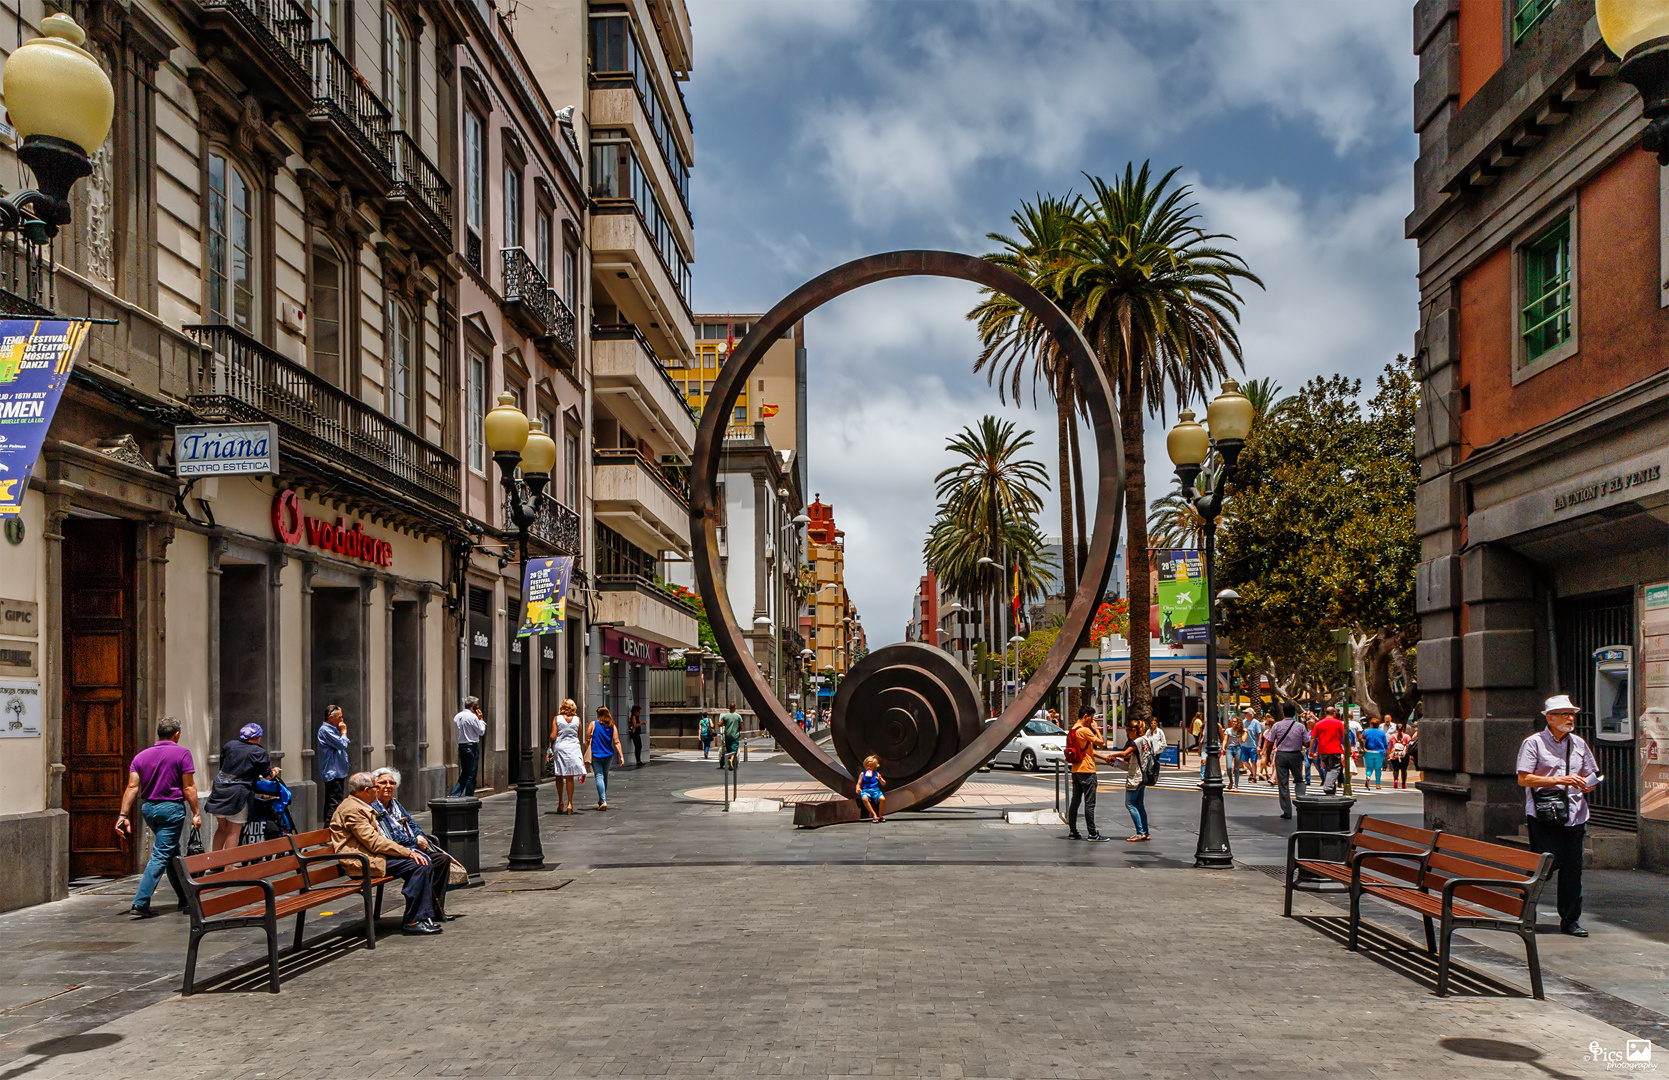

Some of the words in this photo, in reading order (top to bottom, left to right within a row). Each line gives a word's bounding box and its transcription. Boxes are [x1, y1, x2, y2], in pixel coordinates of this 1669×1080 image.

[28, 335, 67, 344] FESTIVAL
[57, 352, 65, 360] Y
[20, 361, 48, 369] DANZA
[184, 432, 268, 459] Triana
[180, 464, 220, 473] CENTRO
[223, 461, 269, 471] ESTÉTICA
[1554, 496, 1567, 513] LA
[1568, 486, 1597, 506] UNION
[1600, 482, 1607, 497] Y
[1610, 477, 1623, 494] EL
[1625, 465, 1660, 489] FENIX
[304, 517, 393, 567] vodafone
[5, 610, 31, 623] GIPIC
[512, 639, 521, 653] siet
[623, 637, 651, 659] DENTIX
